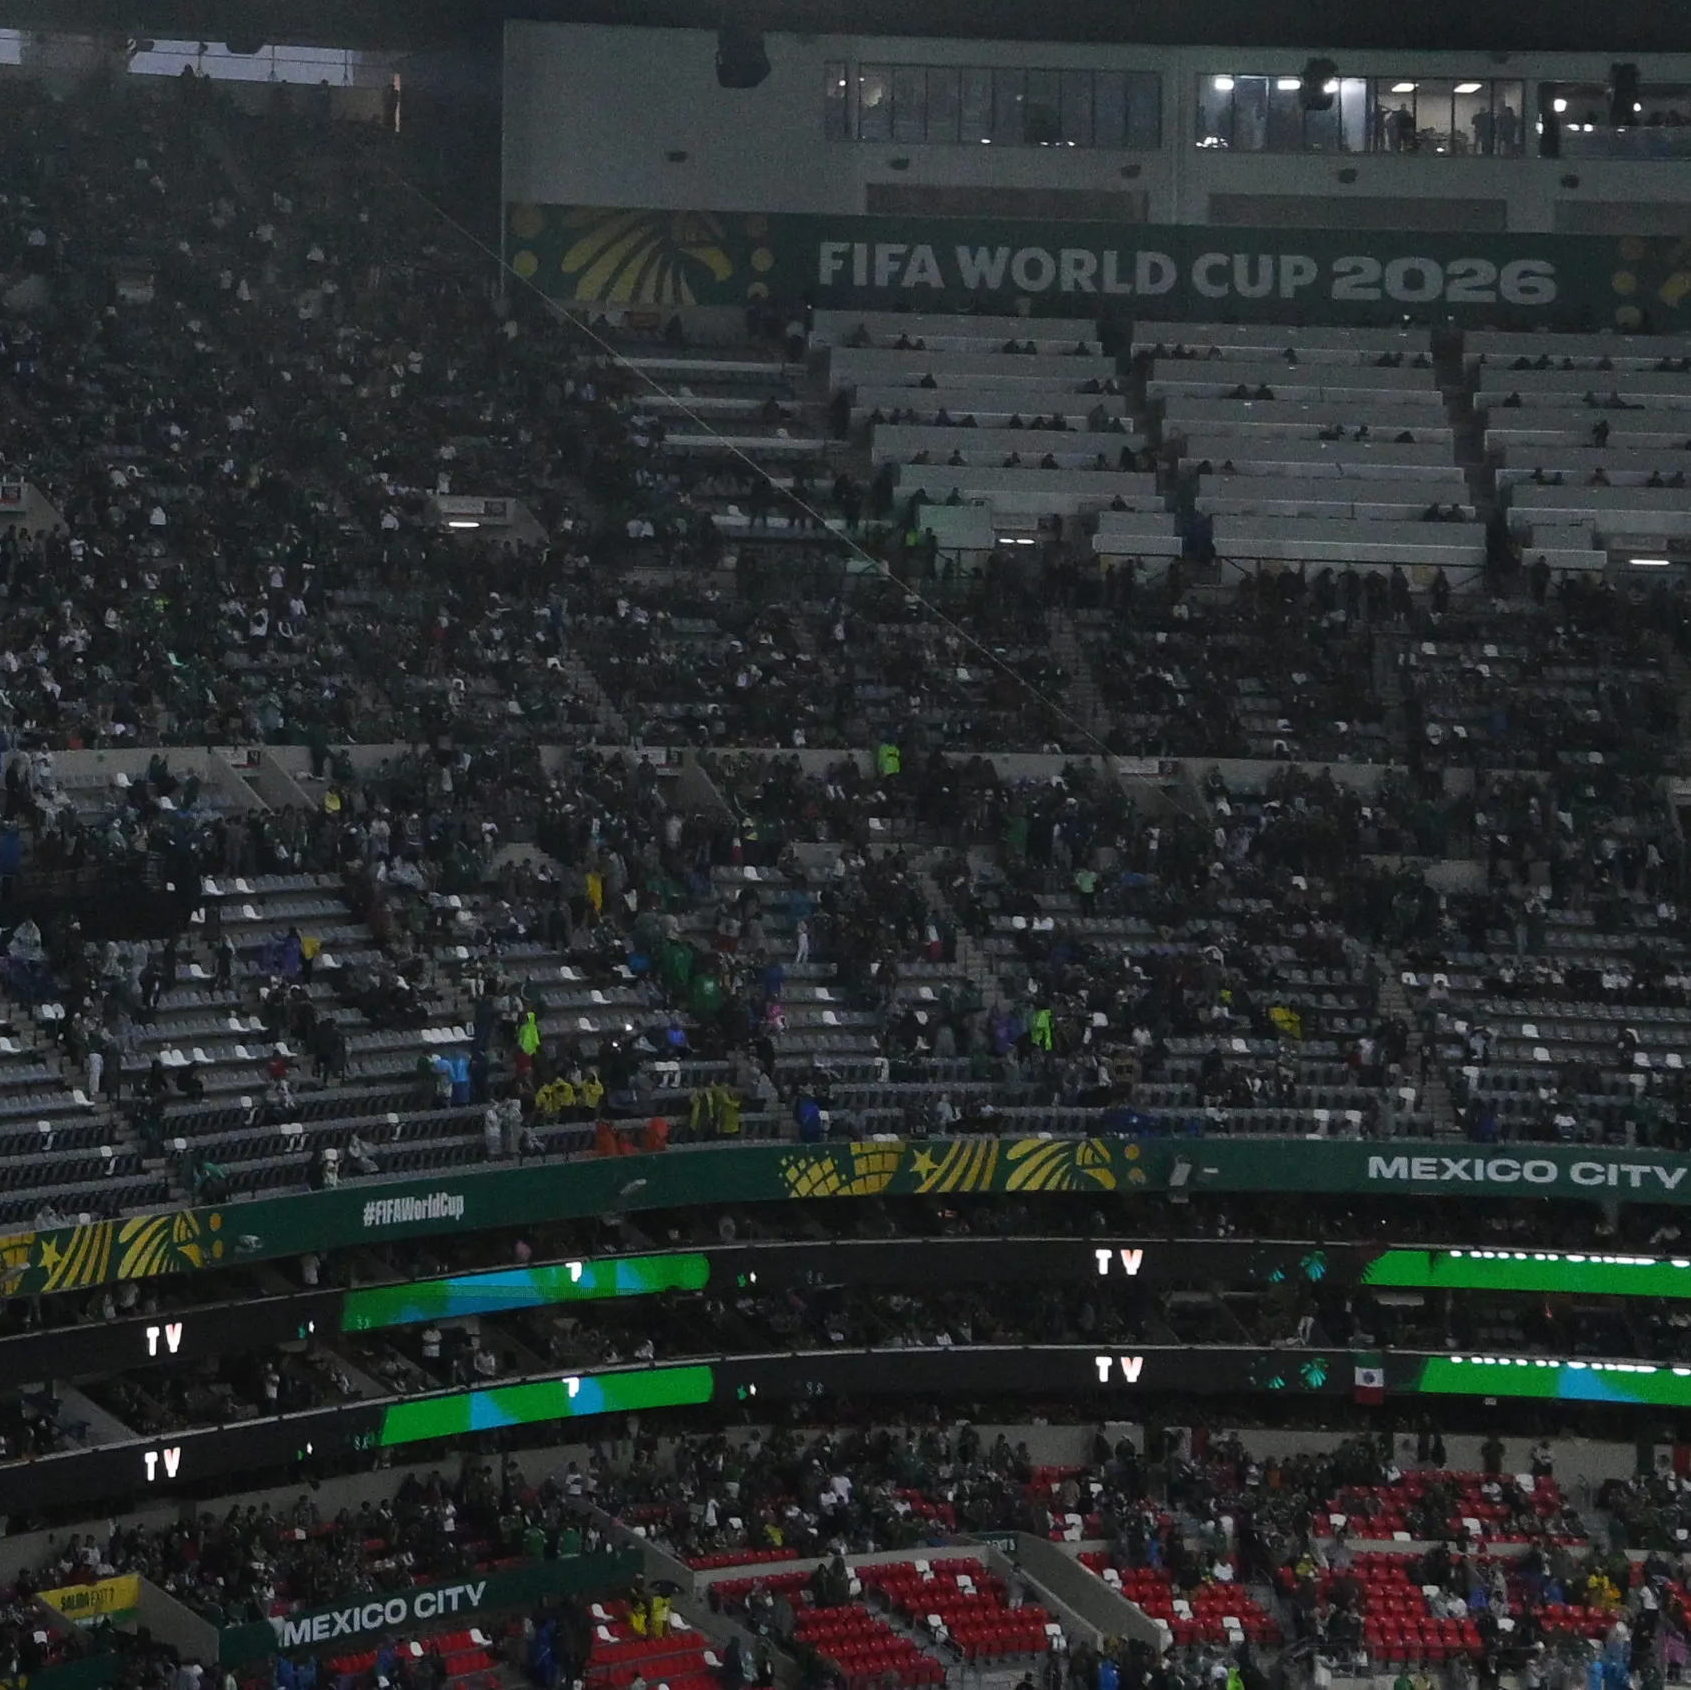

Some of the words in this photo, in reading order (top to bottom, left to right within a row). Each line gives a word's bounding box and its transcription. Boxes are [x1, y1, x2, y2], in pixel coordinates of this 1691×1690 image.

[819, 240, 943, 291] FIFA
[957, 245, 1177, 298] WORLD
[1192, 252, 1320, 301] CUP
[1331, 255, 1558, 306] 2026
[1368, 1155, 1558, 1185] MEXICO
[1569, 1160, 1688, 1190] CITY
[363, 1191, 465, 1227] #FIFAWorldCup
[283, 1597, 408, 1647] MEXICO
[414, 1580, 487, 1620] CITY
